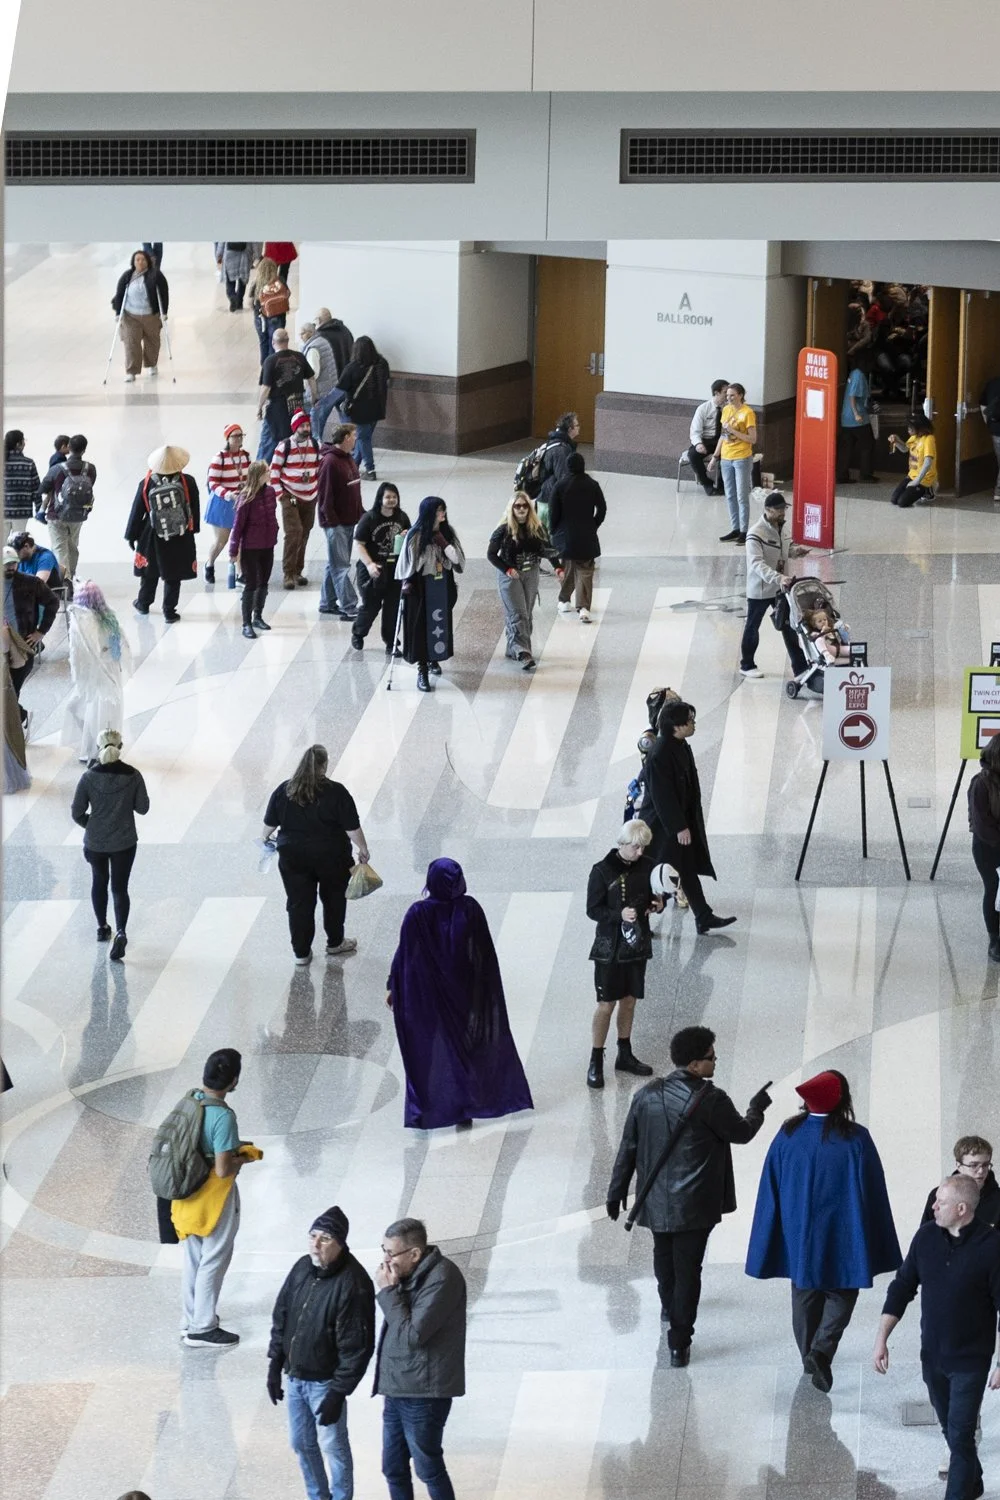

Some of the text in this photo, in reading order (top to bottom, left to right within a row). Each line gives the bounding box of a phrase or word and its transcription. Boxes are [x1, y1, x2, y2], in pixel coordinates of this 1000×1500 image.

[679, 292, 692, 311] A
[657, 312, 713, 326] BALLROOM
[806, 352, 828, 367] MAIN
[804, 365, 829, 380] STAGE
